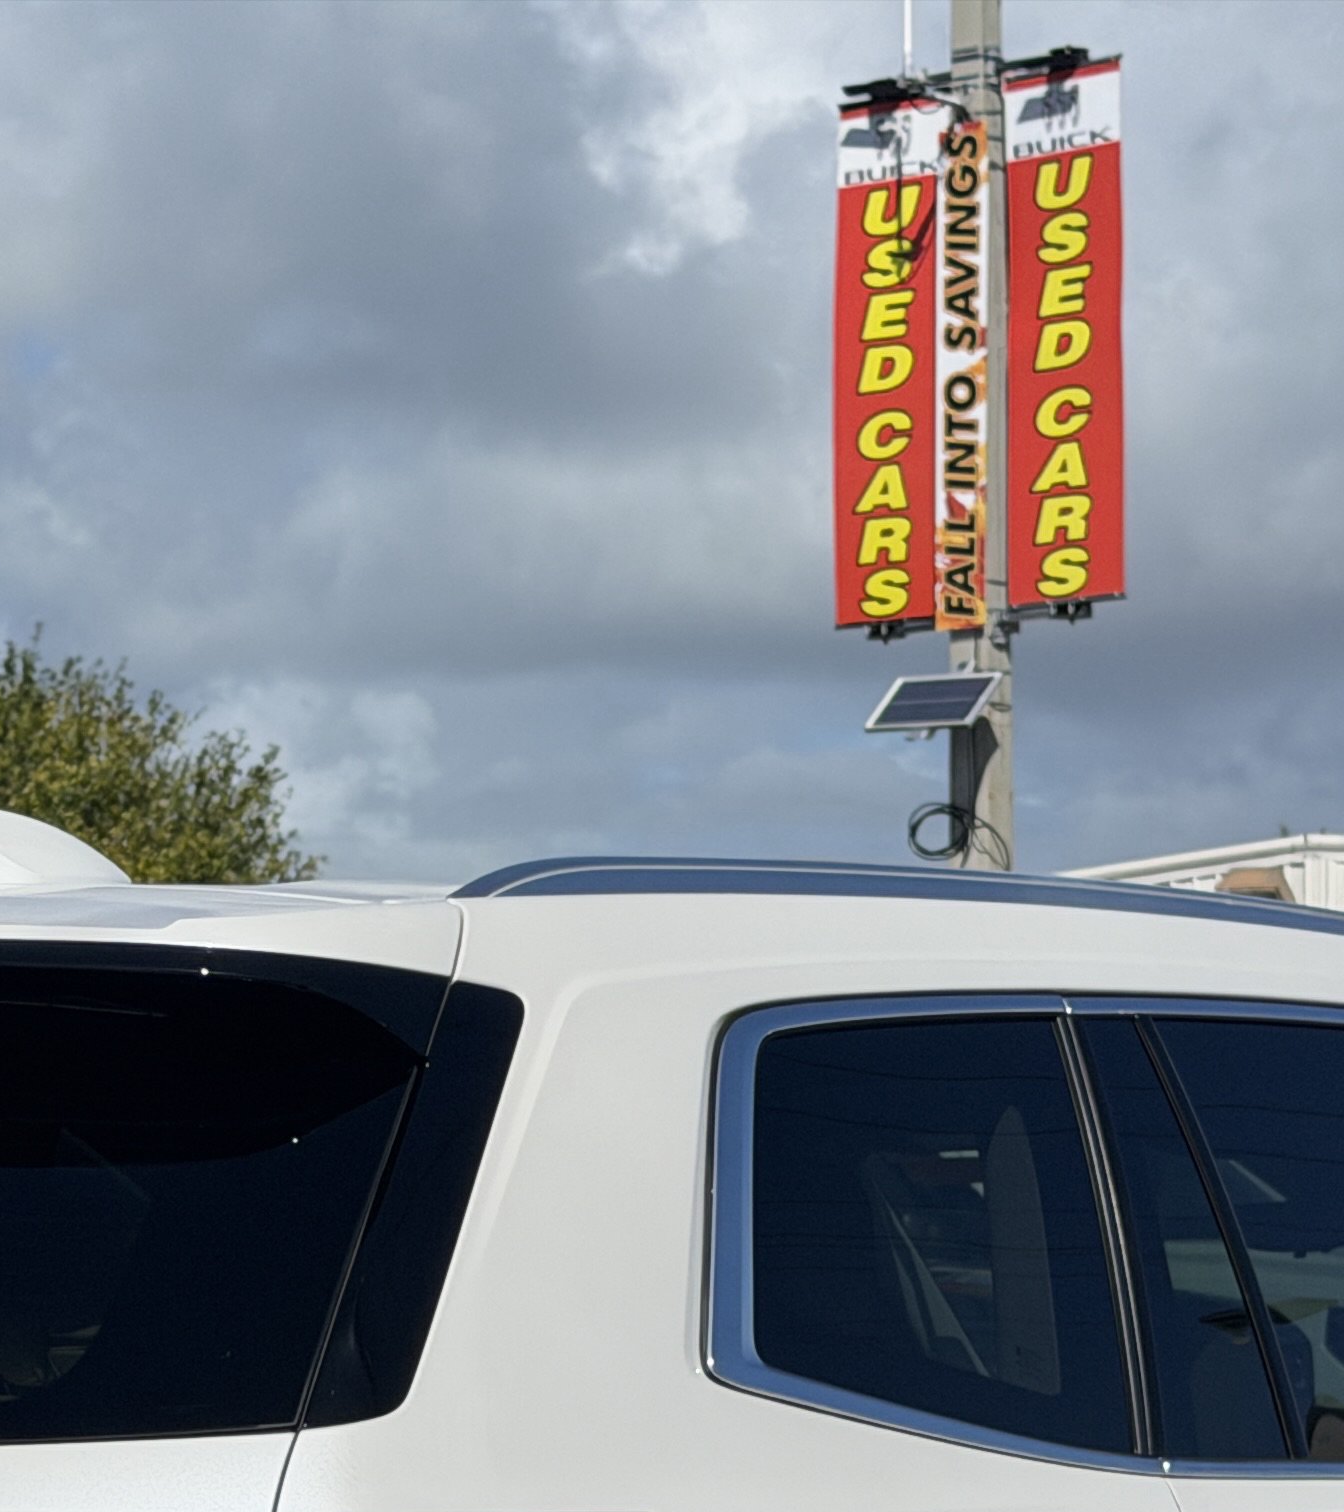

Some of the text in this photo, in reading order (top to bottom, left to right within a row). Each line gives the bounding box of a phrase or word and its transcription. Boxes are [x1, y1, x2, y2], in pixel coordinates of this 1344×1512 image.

[1013, 126, 1112, 160] BUICK
[853, 184, 922, 619] USED CARS
[943, 133, 980, 617] FALL INTO SAVINGS
[1030, 153, 1094, 598] USED CARS
